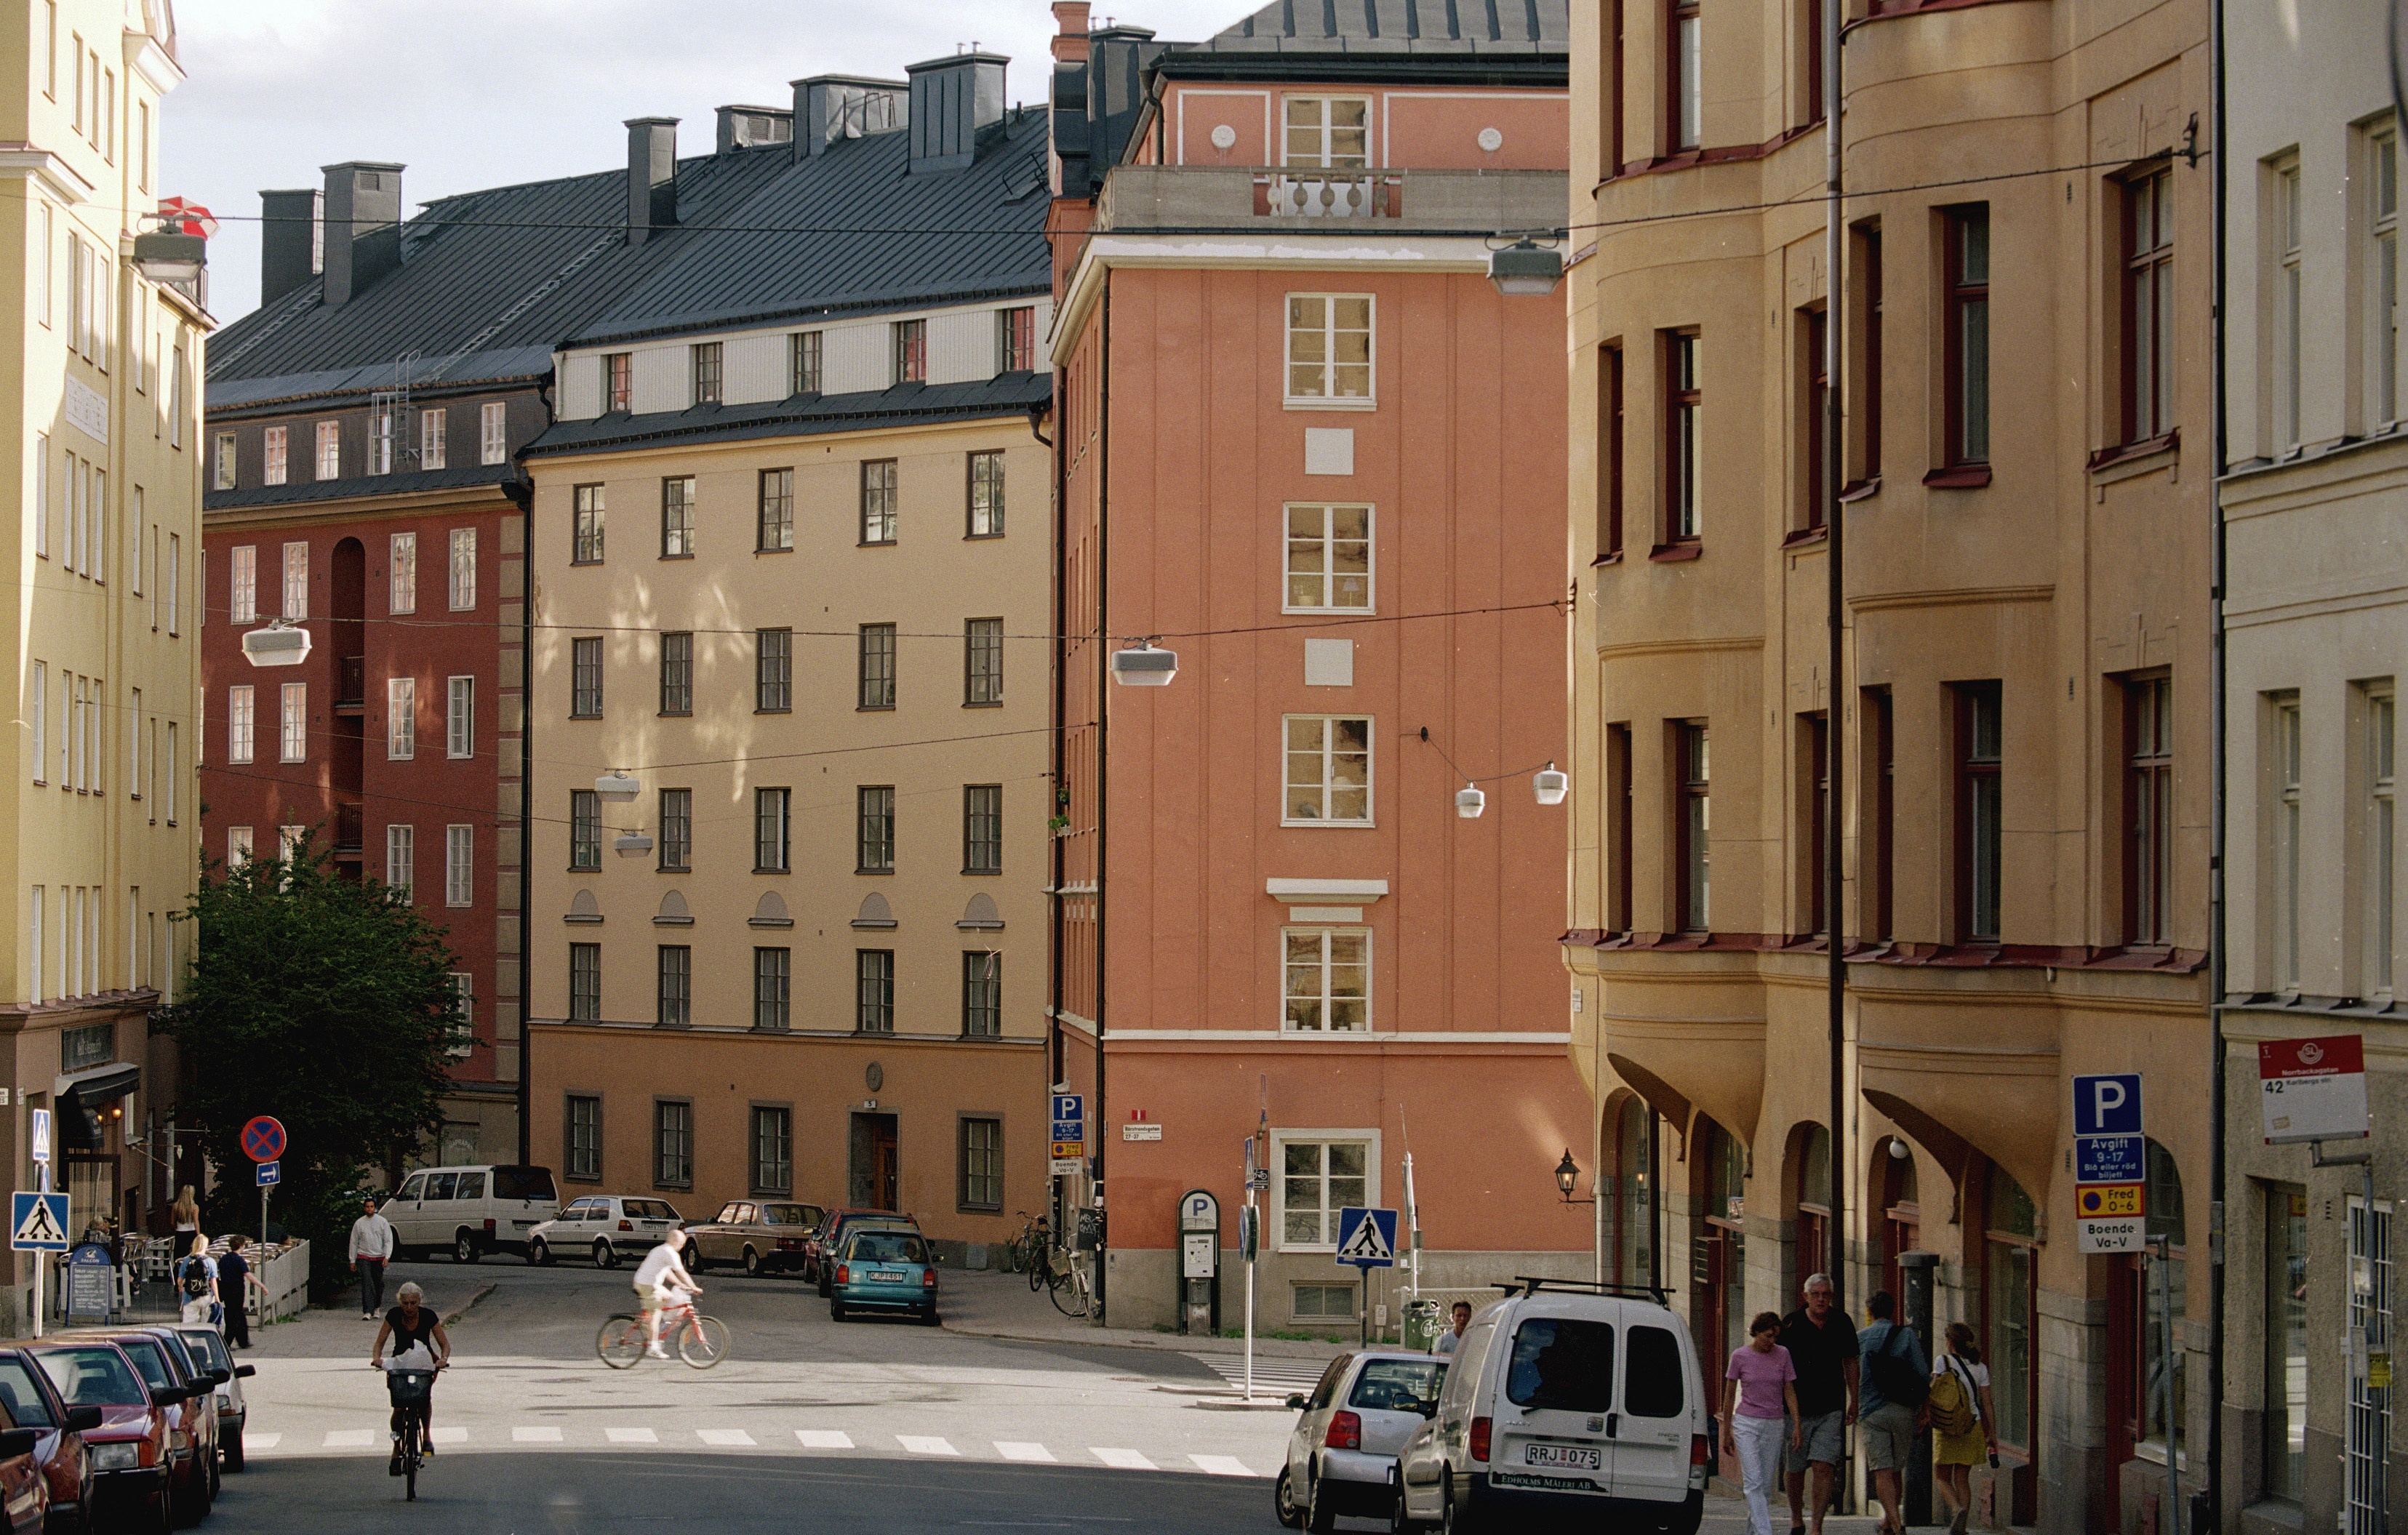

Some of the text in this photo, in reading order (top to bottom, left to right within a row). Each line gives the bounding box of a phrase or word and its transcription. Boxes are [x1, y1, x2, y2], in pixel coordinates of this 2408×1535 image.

[2304, 1046, 2316, 1055] SL
[2282, 1067, 2339, 1076] Norrbackagatan
[2265, 1081, 2284, 1094] 42
[1062, 1098, 1076, 1119] P
[2095, 1081, 2126, 1129] P
[2091, 1138, 2129, 1151] Avgift
[2097, 1151, 2124, 1163] 9-17
[2084, 1163, 2097, 1171] Blå
[2099, 1171, 2123, 1180] biljett
[2108, 1189, 2134, 1200] Fred
[1193, 1198, 1208, 1217] P
[2108, 1201, 2134, 1211] 0-6
[2088, 1224, 2135, 1235] Boende
[2096, 1238, 2127, 1248] Va-V
[1529, 1447, 1597, 1464] RRJ 075
[1501, 1475, 1541, 1486] EDHOLMS
[1544, 1478, 1575, 1488] MÅLERI
